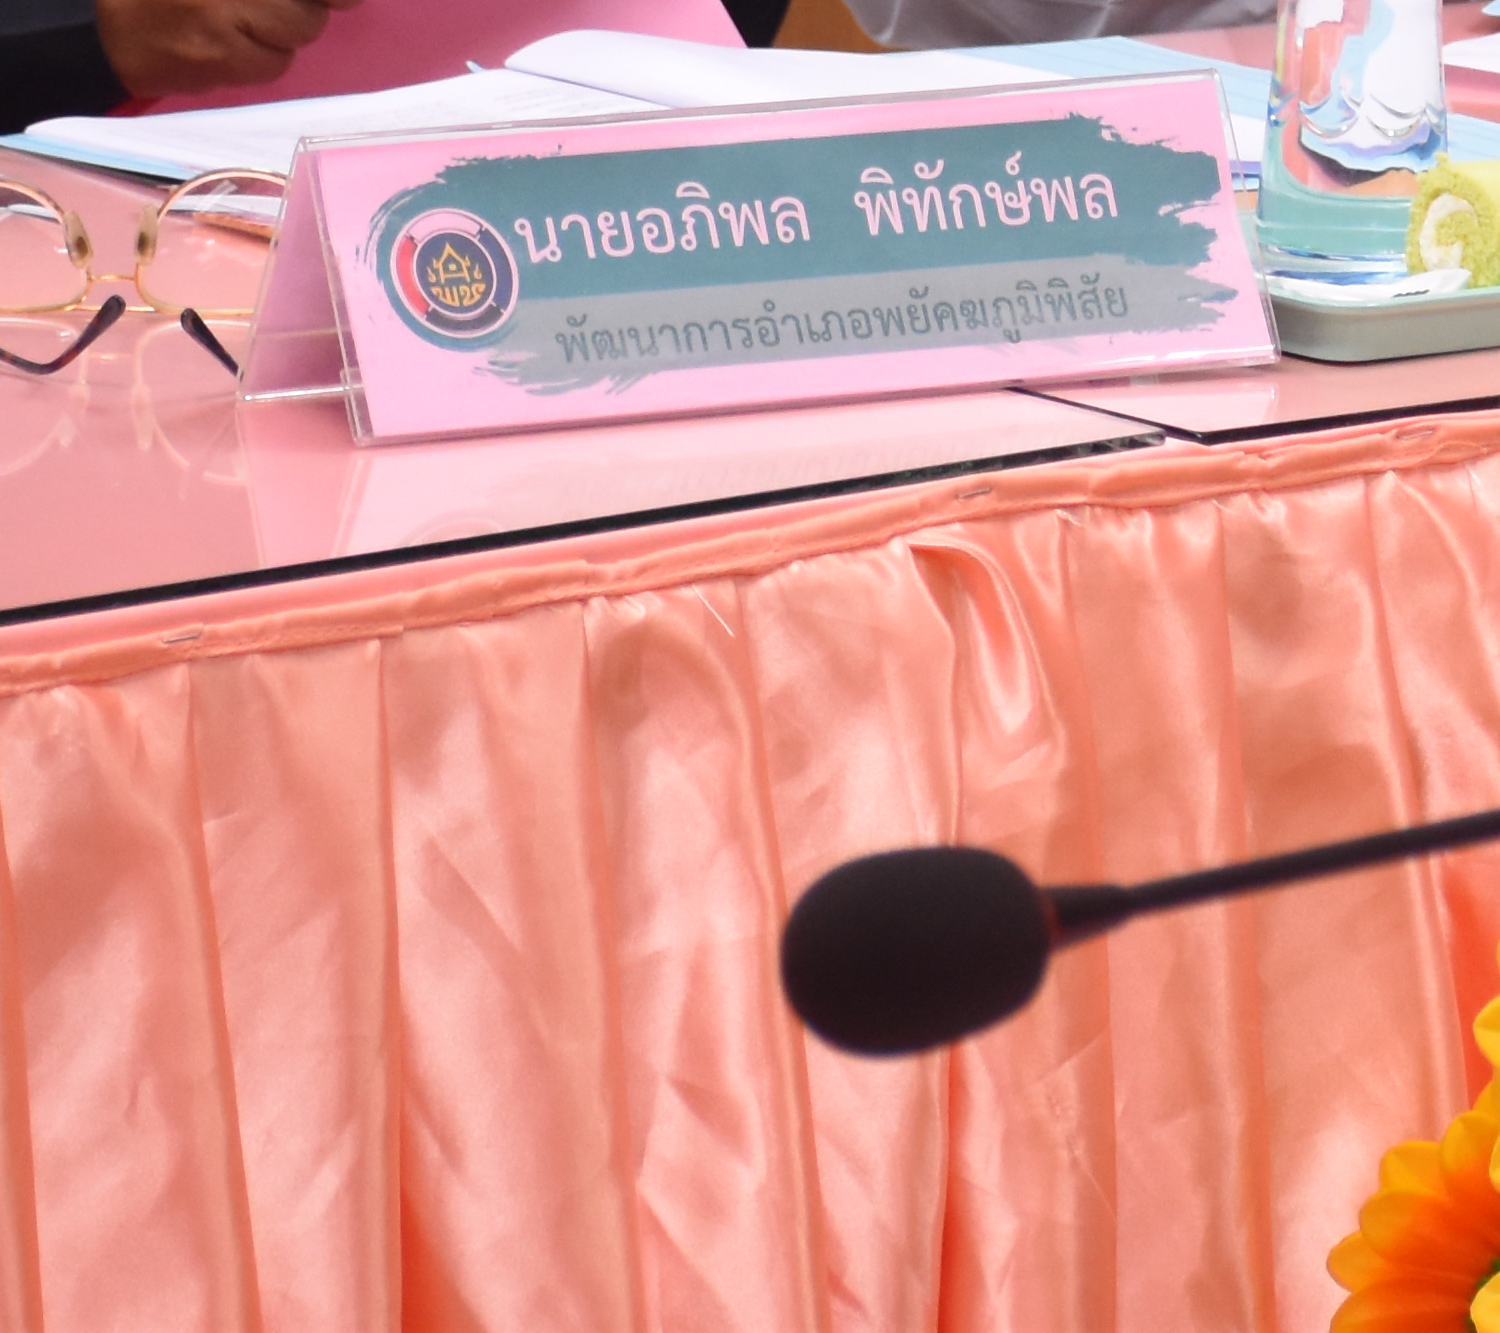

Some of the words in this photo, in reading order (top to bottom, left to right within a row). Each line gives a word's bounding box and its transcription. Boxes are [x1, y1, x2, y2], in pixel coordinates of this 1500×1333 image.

[514, 181, 811, 264] นายอภิพล
[854, 152, 1120, 236] พิทักษ์พล
[555, 272, 1130, 365] พัฒนาการอำเภอพยัคฆภูมิพิสัย
